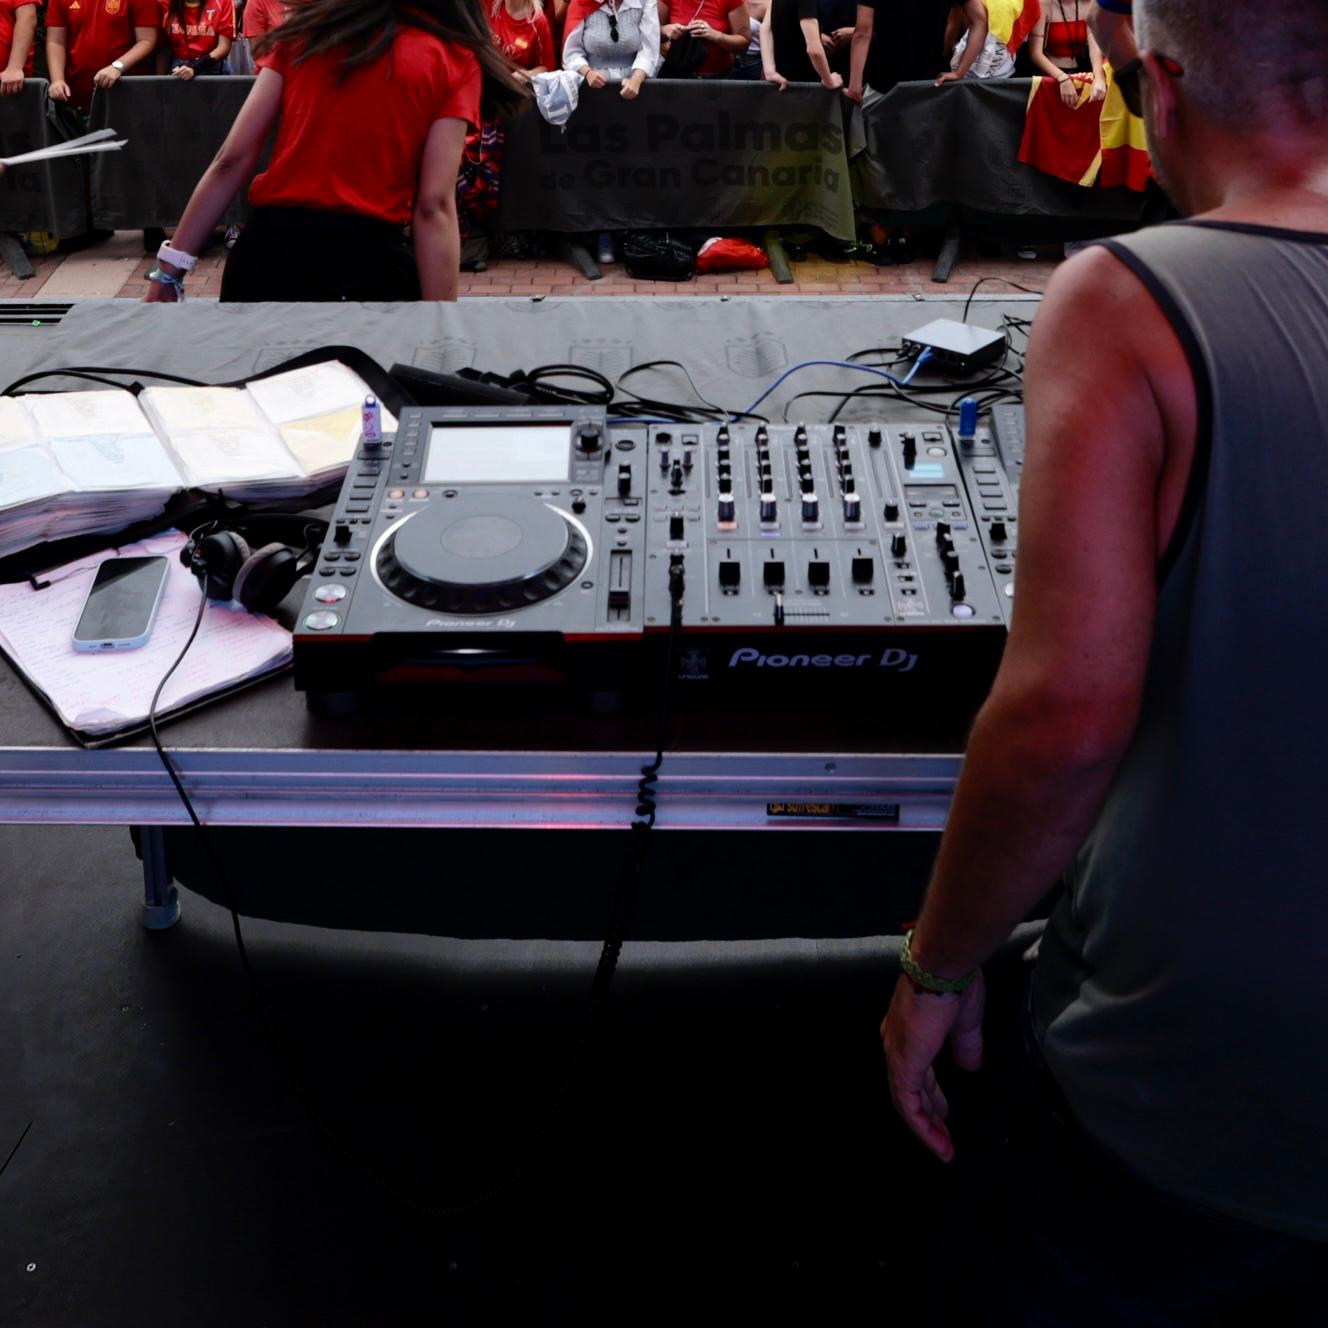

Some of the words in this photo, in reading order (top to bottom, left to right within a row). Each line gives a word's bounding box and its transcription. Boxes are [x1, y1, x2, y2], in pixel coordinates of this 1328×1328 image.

[540, 116, 632, 154] Las
[646, 110, 843, 154] Palmas
[540, 168, 576, 190] de
[583, 158, 682, 189] Gran
[689, 156, 841, 193] Canaria
[728, 647, 871, 669] Pioneer
